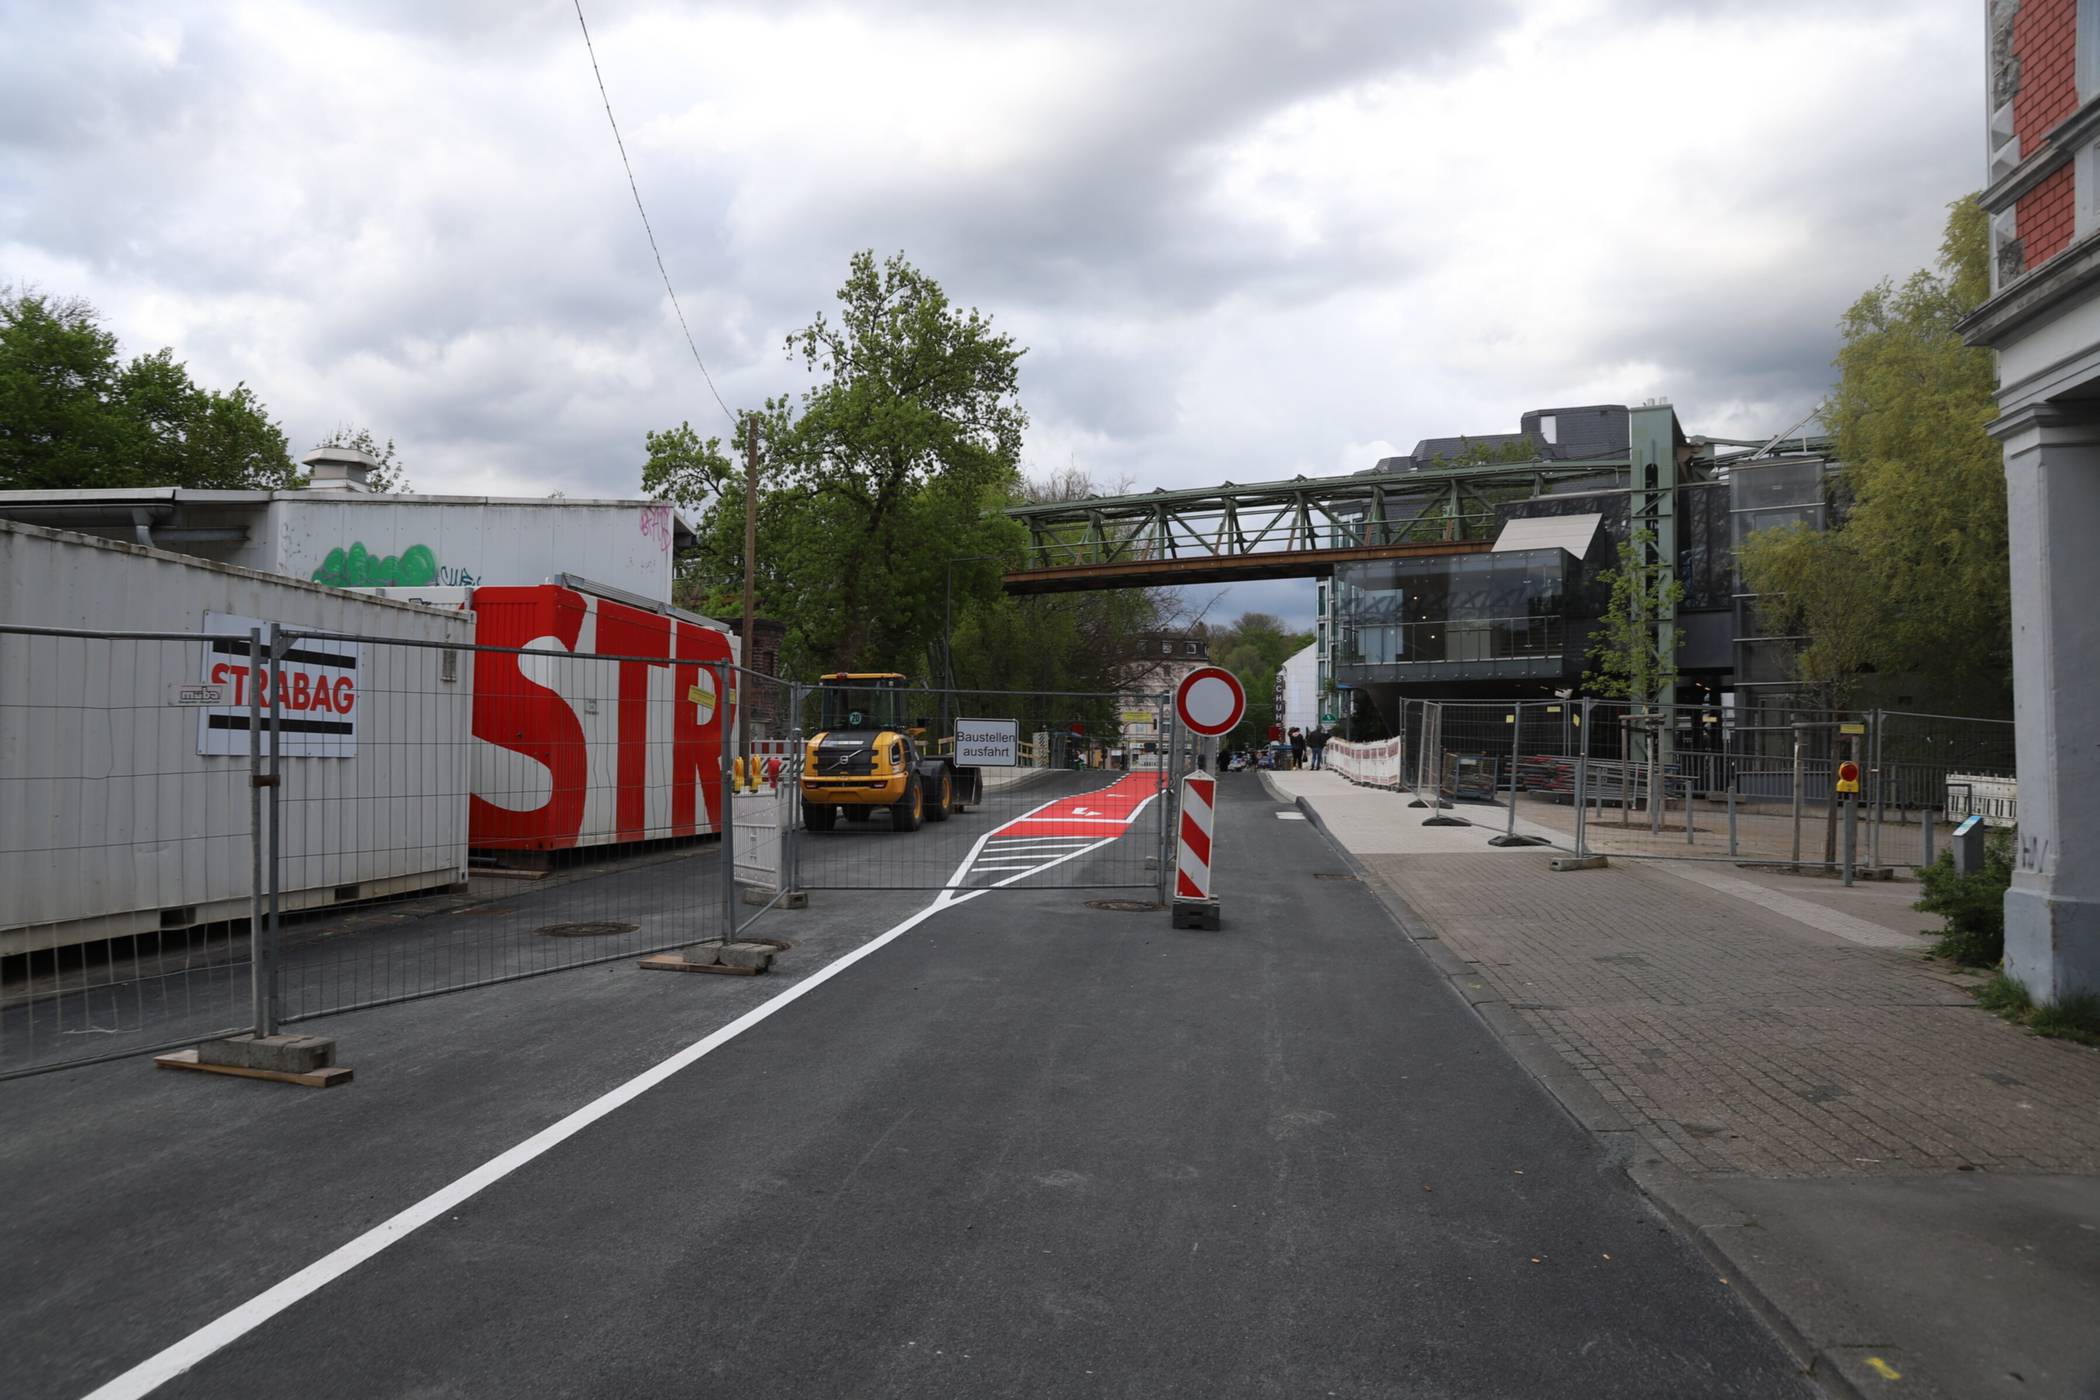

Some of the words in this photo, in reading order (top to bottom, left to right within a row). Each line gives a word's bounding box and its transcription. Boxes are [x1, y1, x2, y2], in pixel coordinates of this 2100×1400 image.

[212, 663, 354, 714] STRABAG
[957, 731, 1016, 743] Baustellen
[963, 746, 1009, 757] ausfahrt
